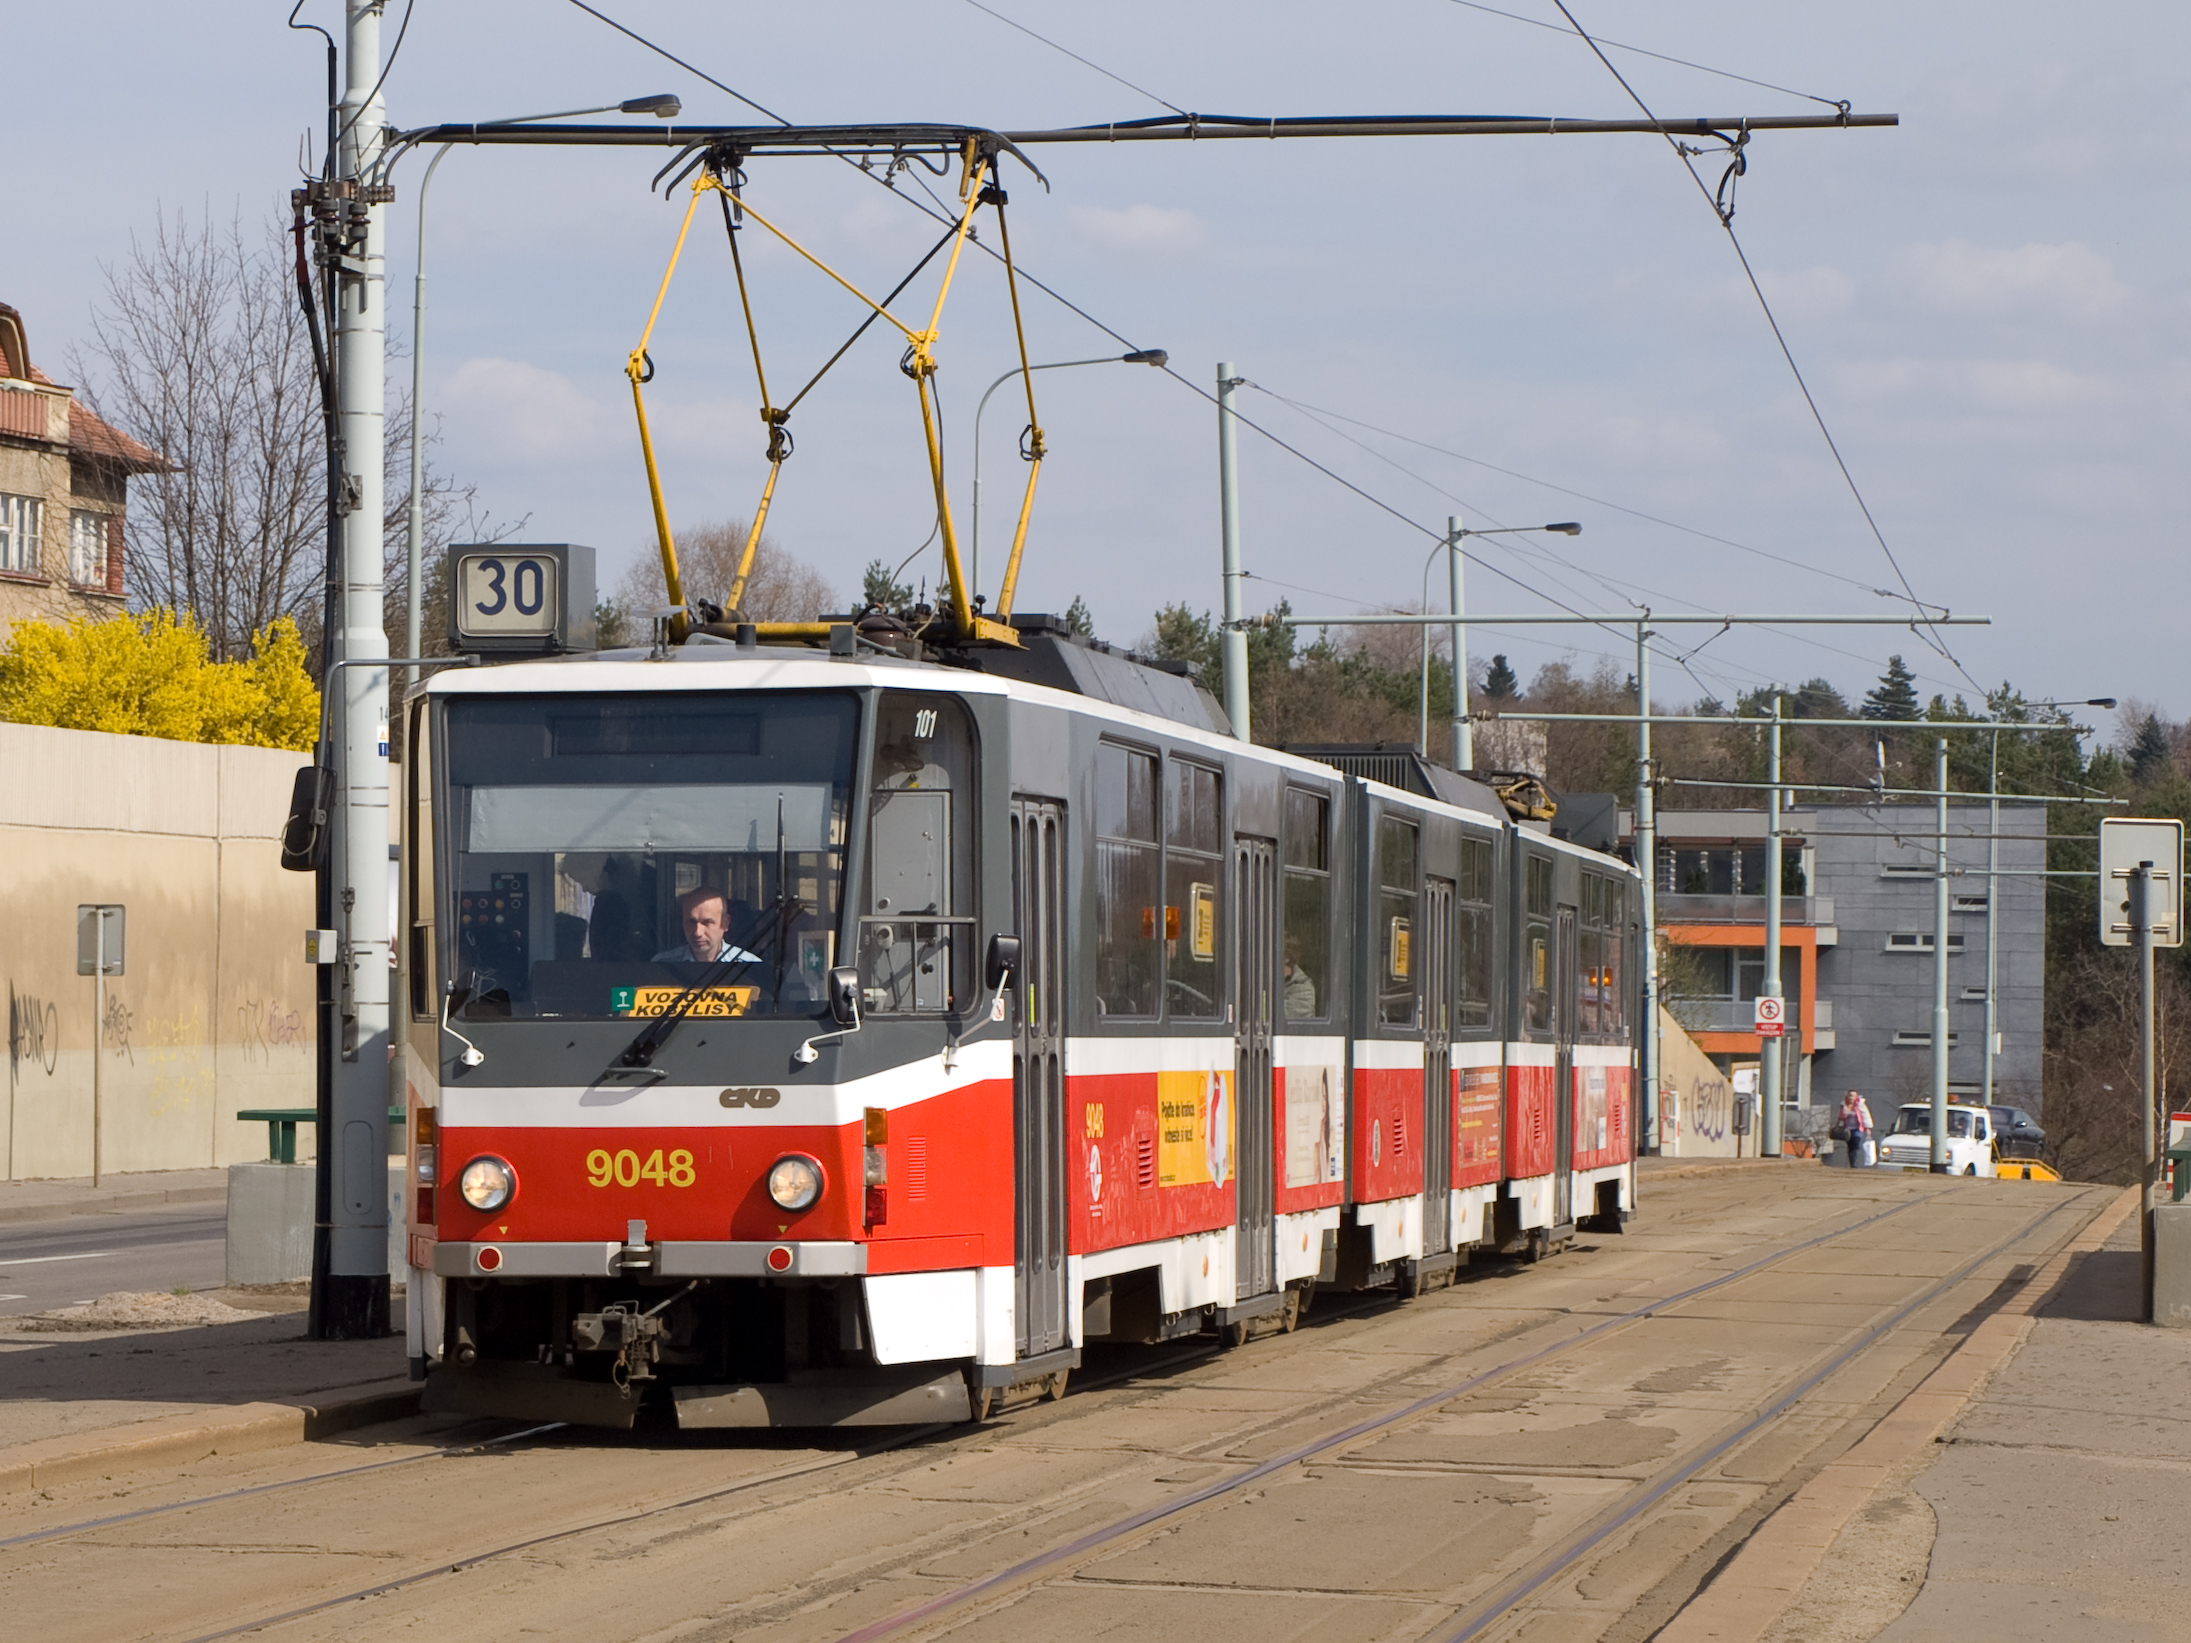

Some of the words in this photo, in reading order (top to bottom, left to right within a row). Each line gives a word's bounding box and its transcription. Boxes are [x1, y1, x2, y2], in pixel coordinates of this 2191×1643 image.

[475, 559, 543, 616] 30
[914, 709, 938, 738] 101
[1086, 1103, 1104, 1138] 9048
[586, 1149, 696, 1187] 9048
